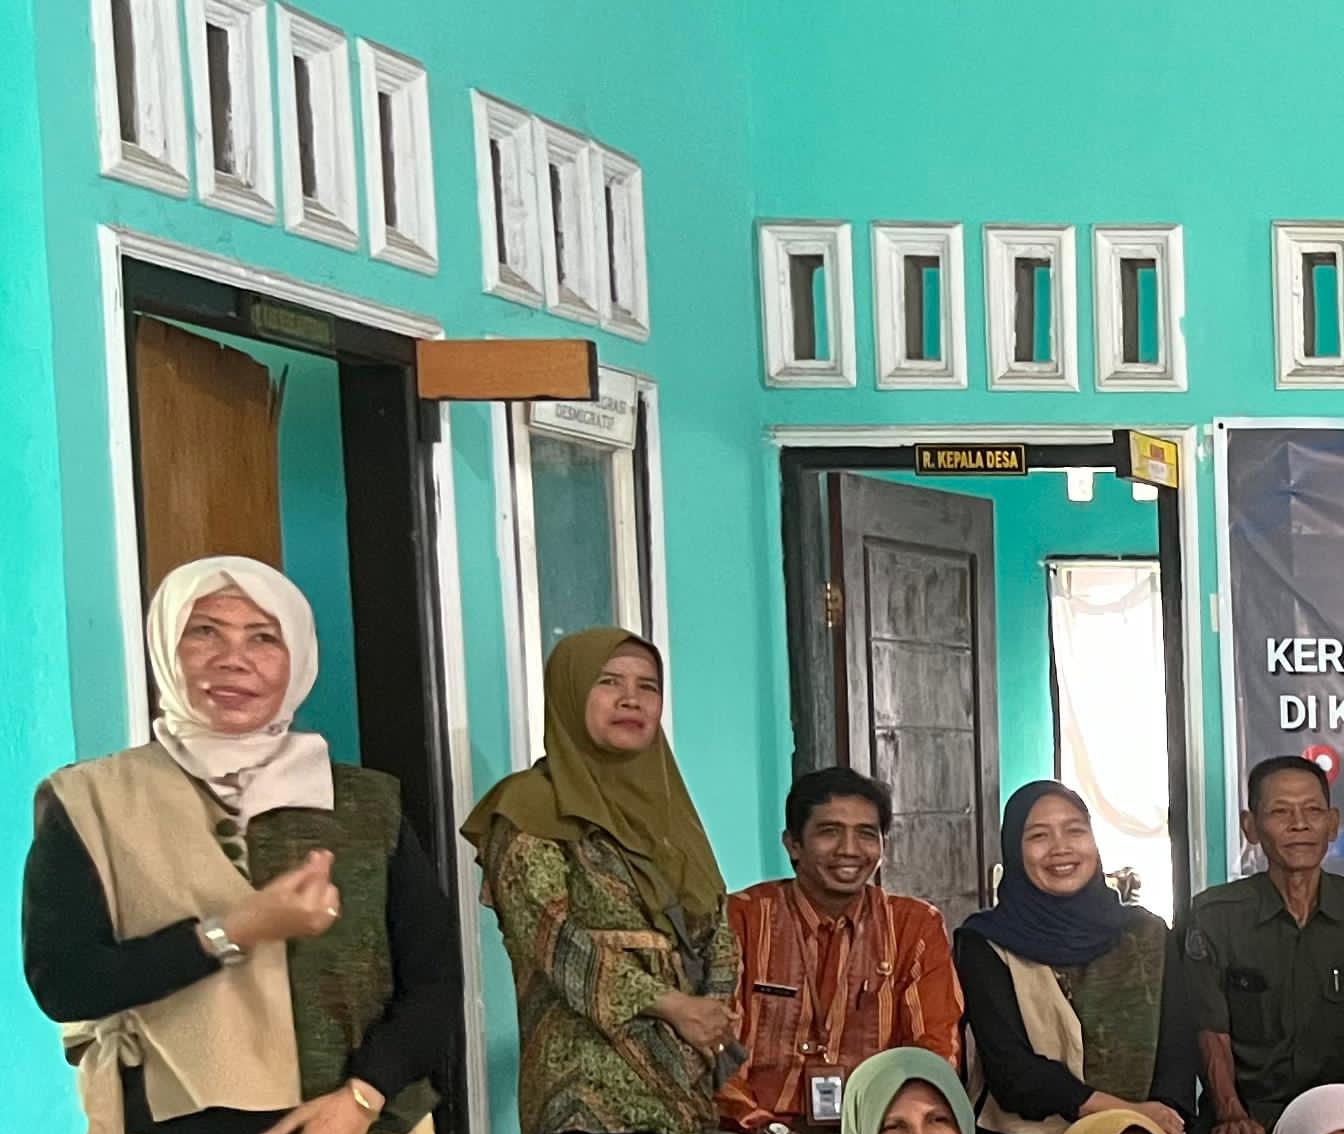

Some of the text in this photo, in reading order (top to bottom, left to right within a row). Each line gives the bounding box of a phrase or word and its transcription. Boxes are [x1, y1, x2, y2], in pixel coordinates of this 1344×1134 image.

[922, 450, 1019, 469] R. KEPALA DESA
[1280, 695, 1317, 730] DI
